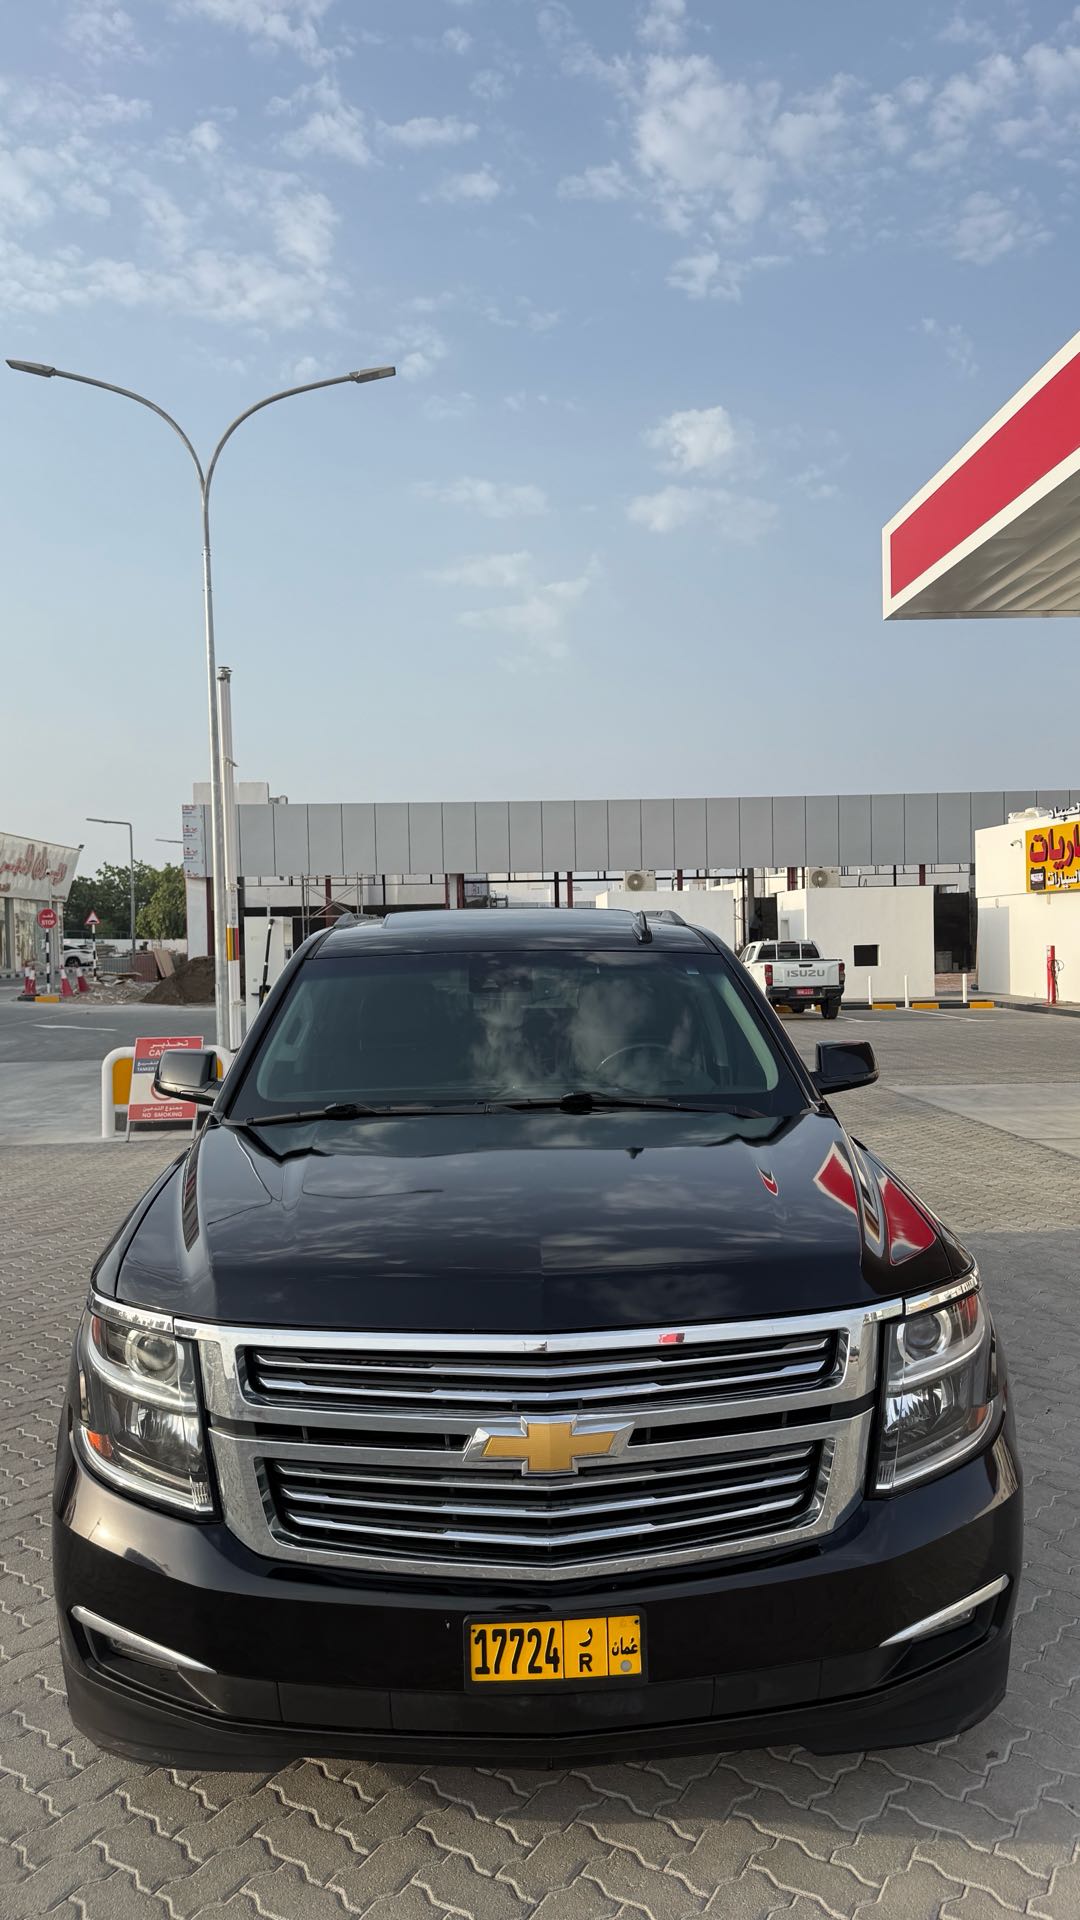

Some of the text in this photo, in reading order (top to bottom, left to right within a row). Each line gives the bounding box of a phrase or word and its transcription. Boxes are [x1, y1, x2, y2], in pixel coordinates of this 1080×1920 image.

[1030, 824, 1080, 870] اريات
[787, 969, 825, 977] ISUZU
[579, 1627, 593, 1647] ر
[474, 1627, 560, 1674] 17724
[579, 1653, 593, 1672] R
